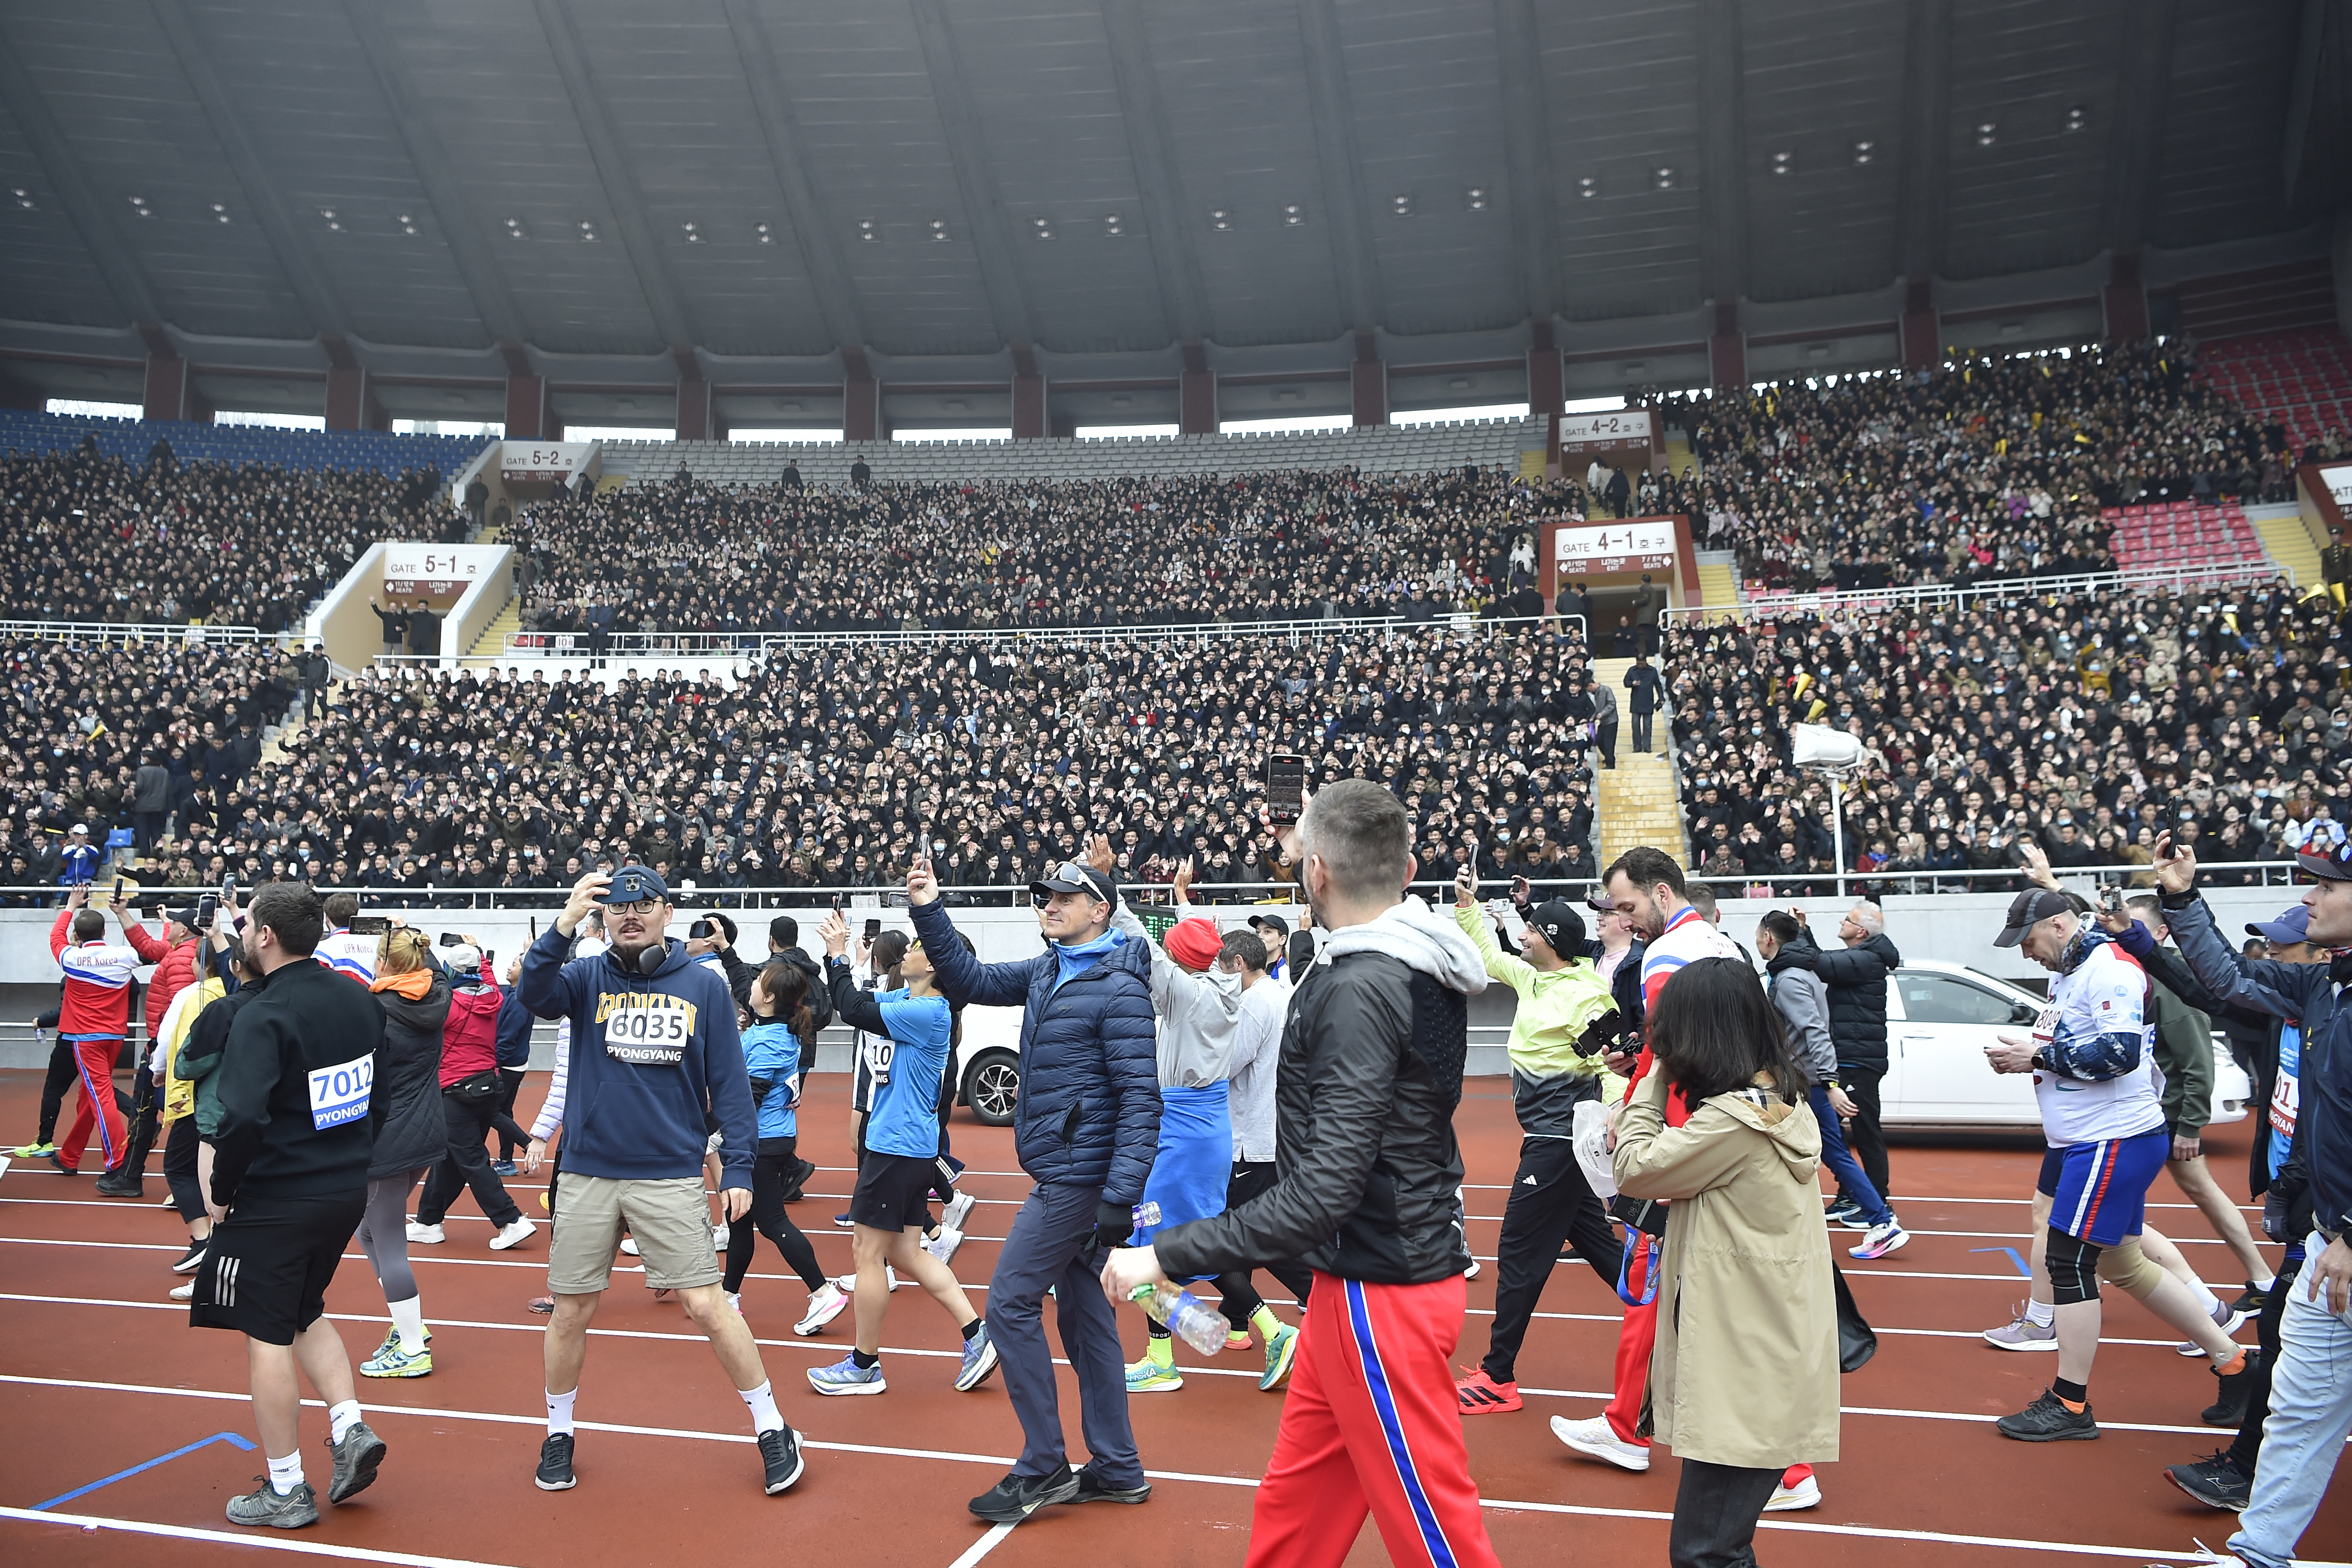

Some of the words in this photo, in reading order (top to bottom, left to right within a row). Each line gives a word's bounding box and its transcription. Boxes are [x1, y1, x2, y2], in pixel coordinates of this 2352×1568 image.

[1591, 418, 1618, 434] 4-2
[532, 450, 558, 465] 5-2
[1563, 543, 1590, 553] GATE
[1598, 531, 1632, 551] 4-1
[391, 565, 416, 573] GATE
[425, 555, 456, 573] 5-1
[343, 943, 355, 954] DPR
[357, 943, 373, 953] Korea
[77, 956, 92, 967] DPR
[95, 956, 118, 966] Korea
[612, 1014, 682, 1040] 6035
[606, 1045, 682, 1062] PYONGYANG
[313, 1061, 371, 1102] 7012
[2268, 1108, 2295, 1134] NGYAN
[1129, 1367, 1157, 1382] HOKA
